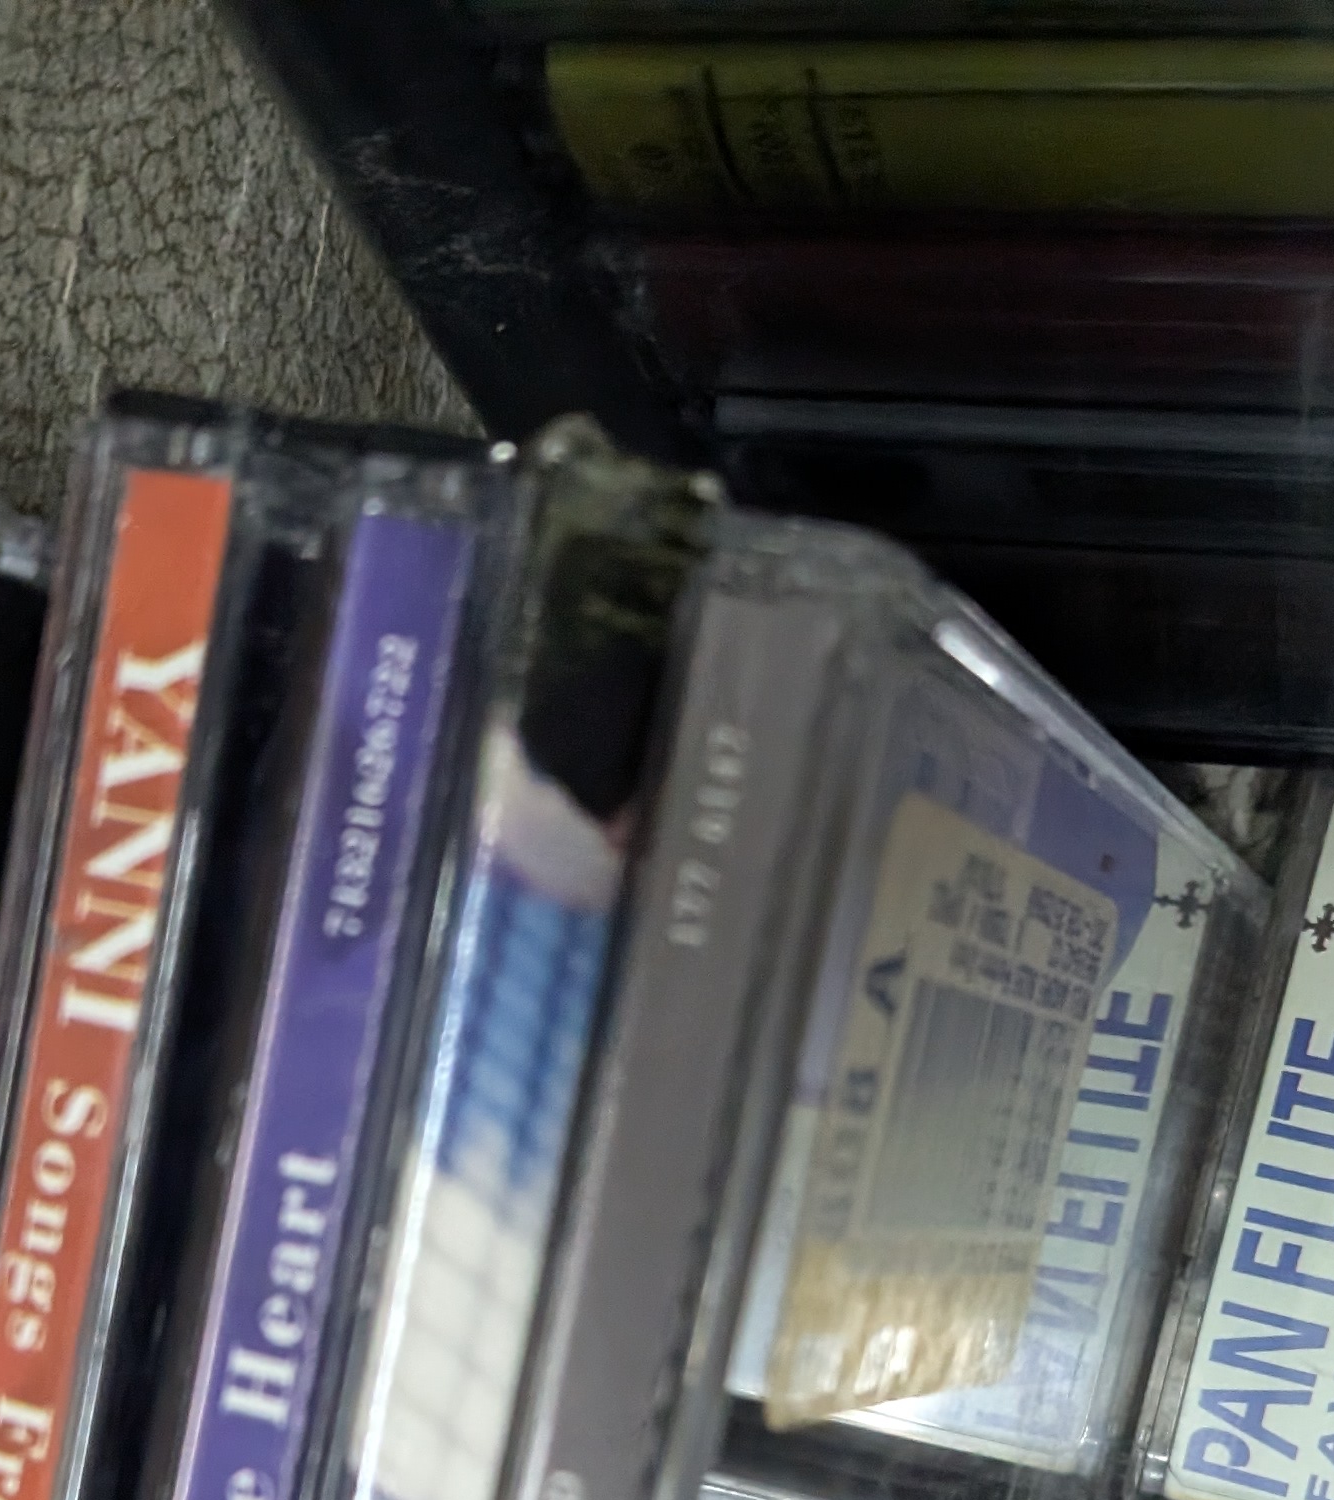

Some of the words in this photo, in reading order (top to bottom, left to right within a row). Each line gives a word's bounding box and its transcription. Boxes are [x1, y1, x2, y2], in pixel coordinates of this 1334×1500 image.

[57, 640, 210, 1034] YANNI
[3, 1078, 108, 1352] Songs
[222, 1149, 339, 1429] Heart
[1183, 1300, 1331, 1498] PAN
